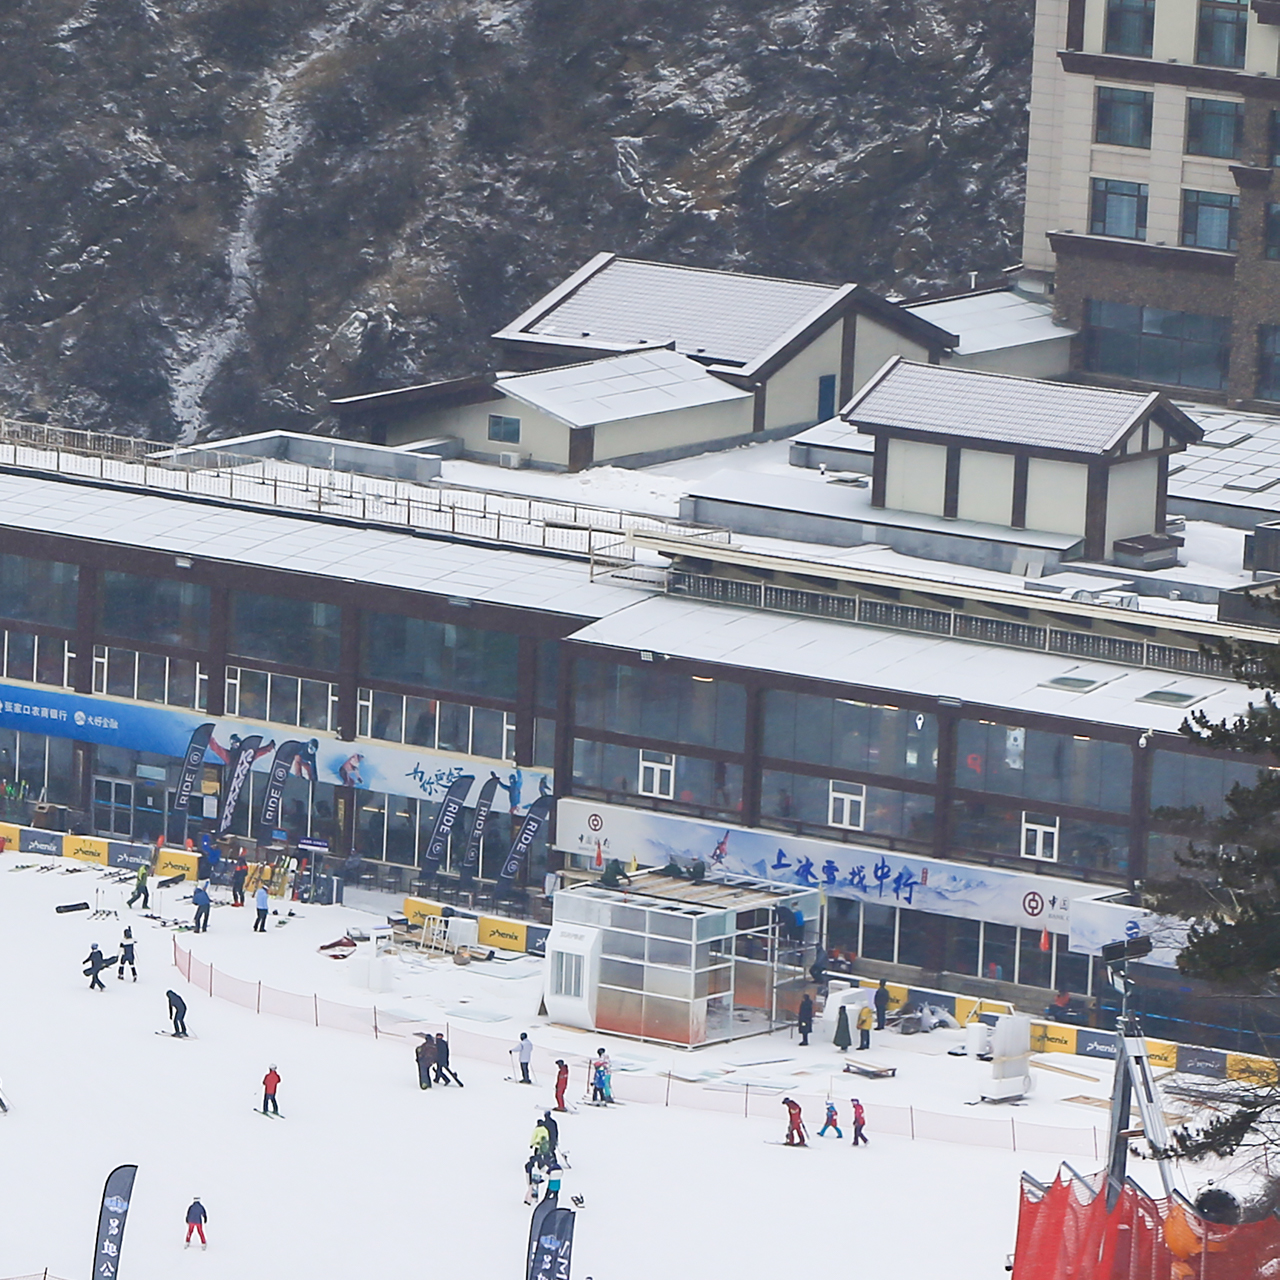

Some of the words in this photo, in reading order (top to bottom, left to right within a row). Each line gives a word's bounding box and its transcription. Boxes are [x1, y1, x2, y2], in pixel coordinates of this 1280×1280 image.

[4, 701, 68, 722] 张家口农商银行
[179, 772, 195, 804] RIDE
[265, 788, 282, 820] RIDE
[439, 802, 459, 834] RIDE
[473, 806, 488, 838] RIDE
[28, 840, 58, 852] phenix
[516, 820, 539, 852] RIDE
[73, 847, 101, 859] phenix
[162, 861, 191, 873] phenix
[771, 848, 920, 905] 上冰雪找中行
[489, 929, 519, 942] phenix
[1037, 1030, 1069, 1046] phenix
